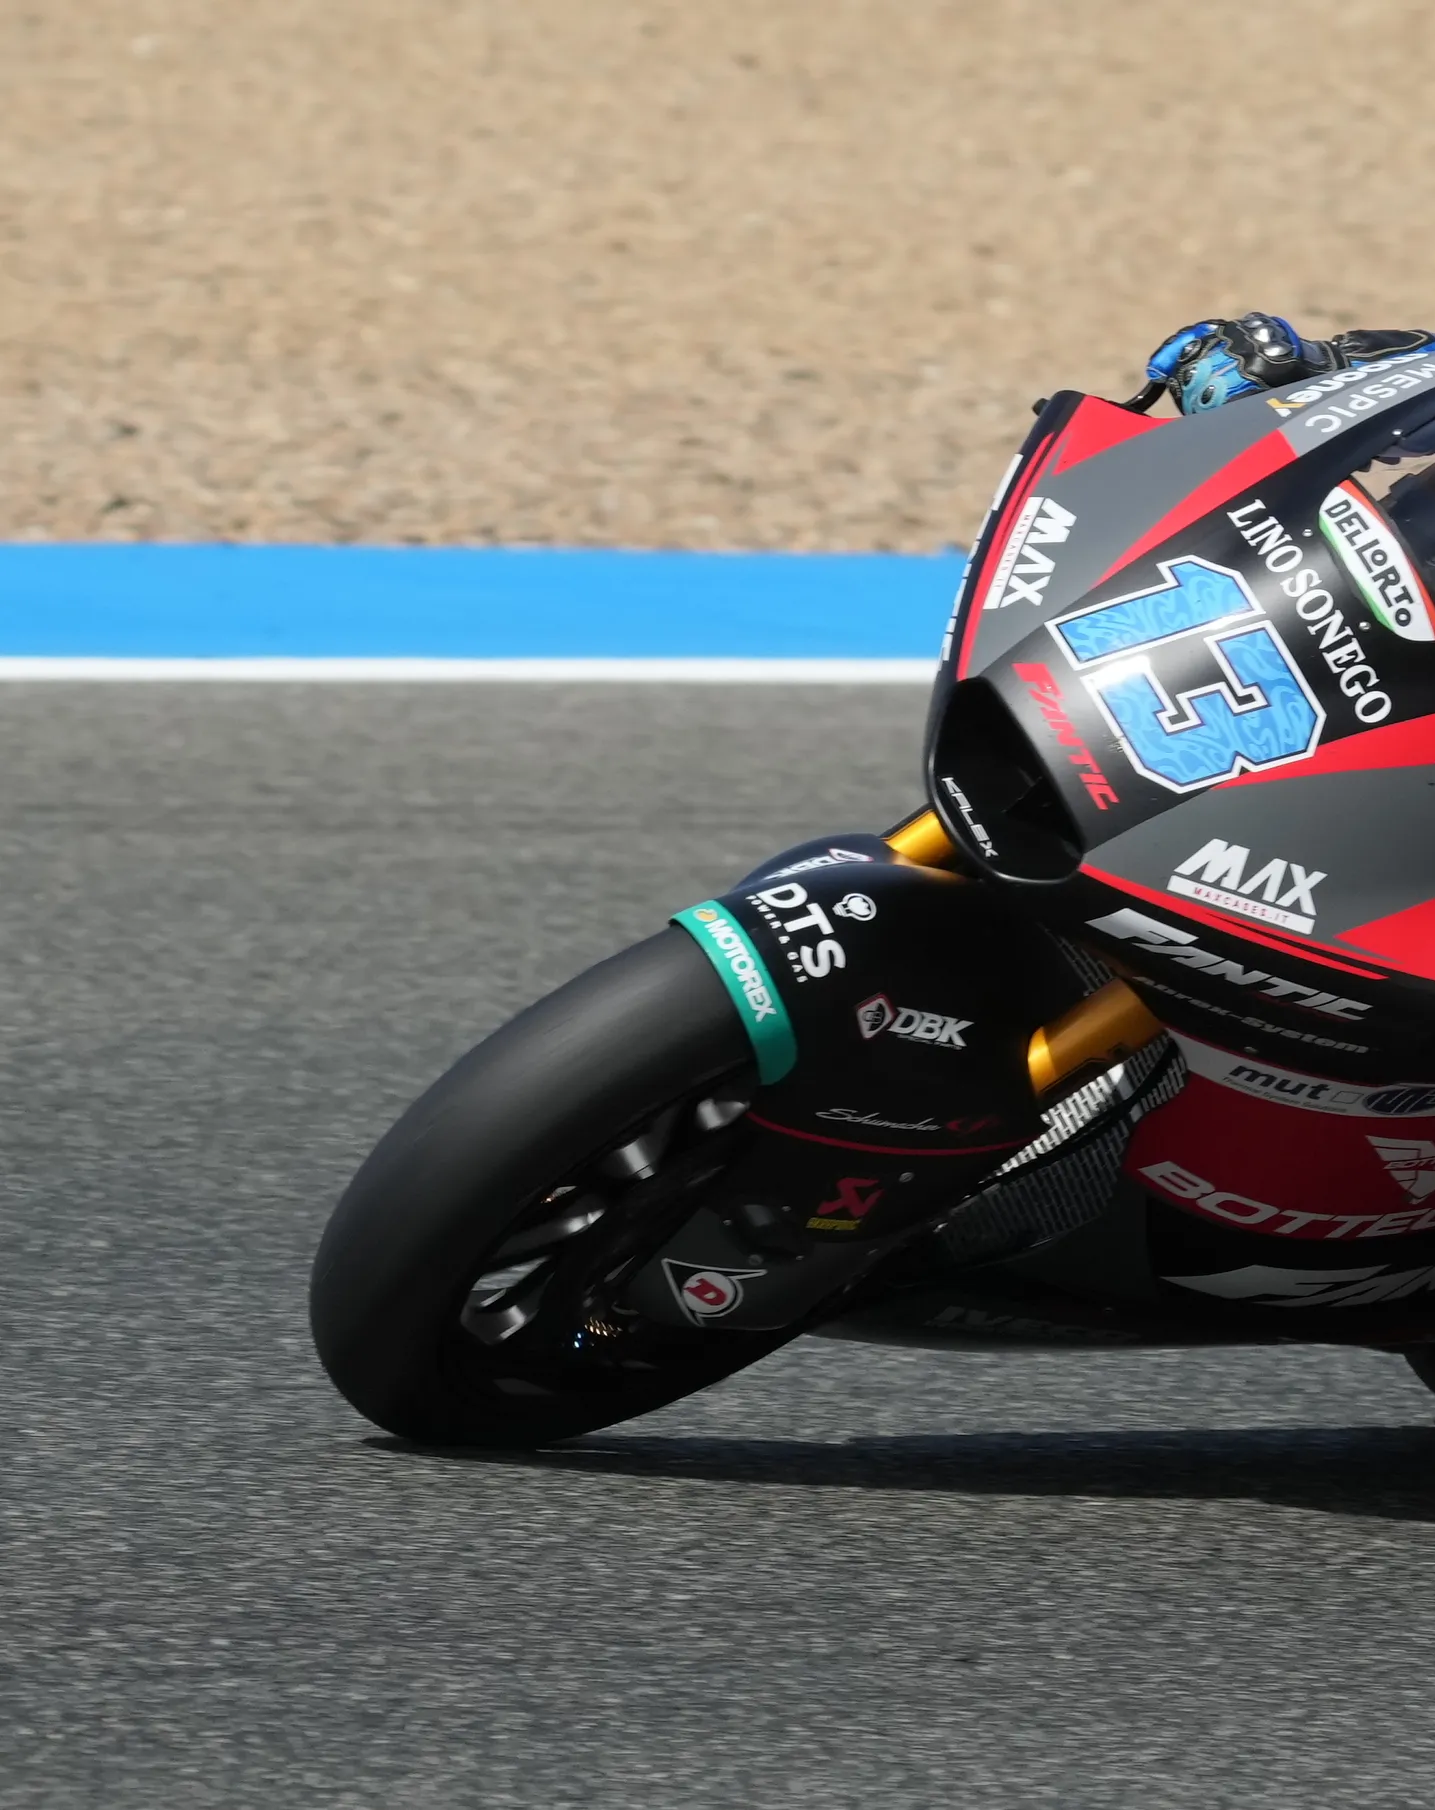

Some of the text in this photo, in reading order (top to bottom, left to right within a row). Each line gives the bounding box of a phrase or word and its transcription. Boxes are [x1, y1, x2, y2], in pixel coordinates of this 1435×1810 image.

[999, 496, 1077, 607] MAX
[1226, 499, 1393, 724] LINO SONEGO
[1045, 554, 1327, 794] 13
[1012, 662, 1119, 811] FANTIC
[757, 882, 846, 979] DTS
[1173, 838, 1328, 917] MAX
[707, 918, 777, 1022] MOTOREX
[1084, 907, 1374, 1022] FANTIC
[886, 1007, 974, 1050] DBK
[1230, 1064, 1335, 1102] mut
